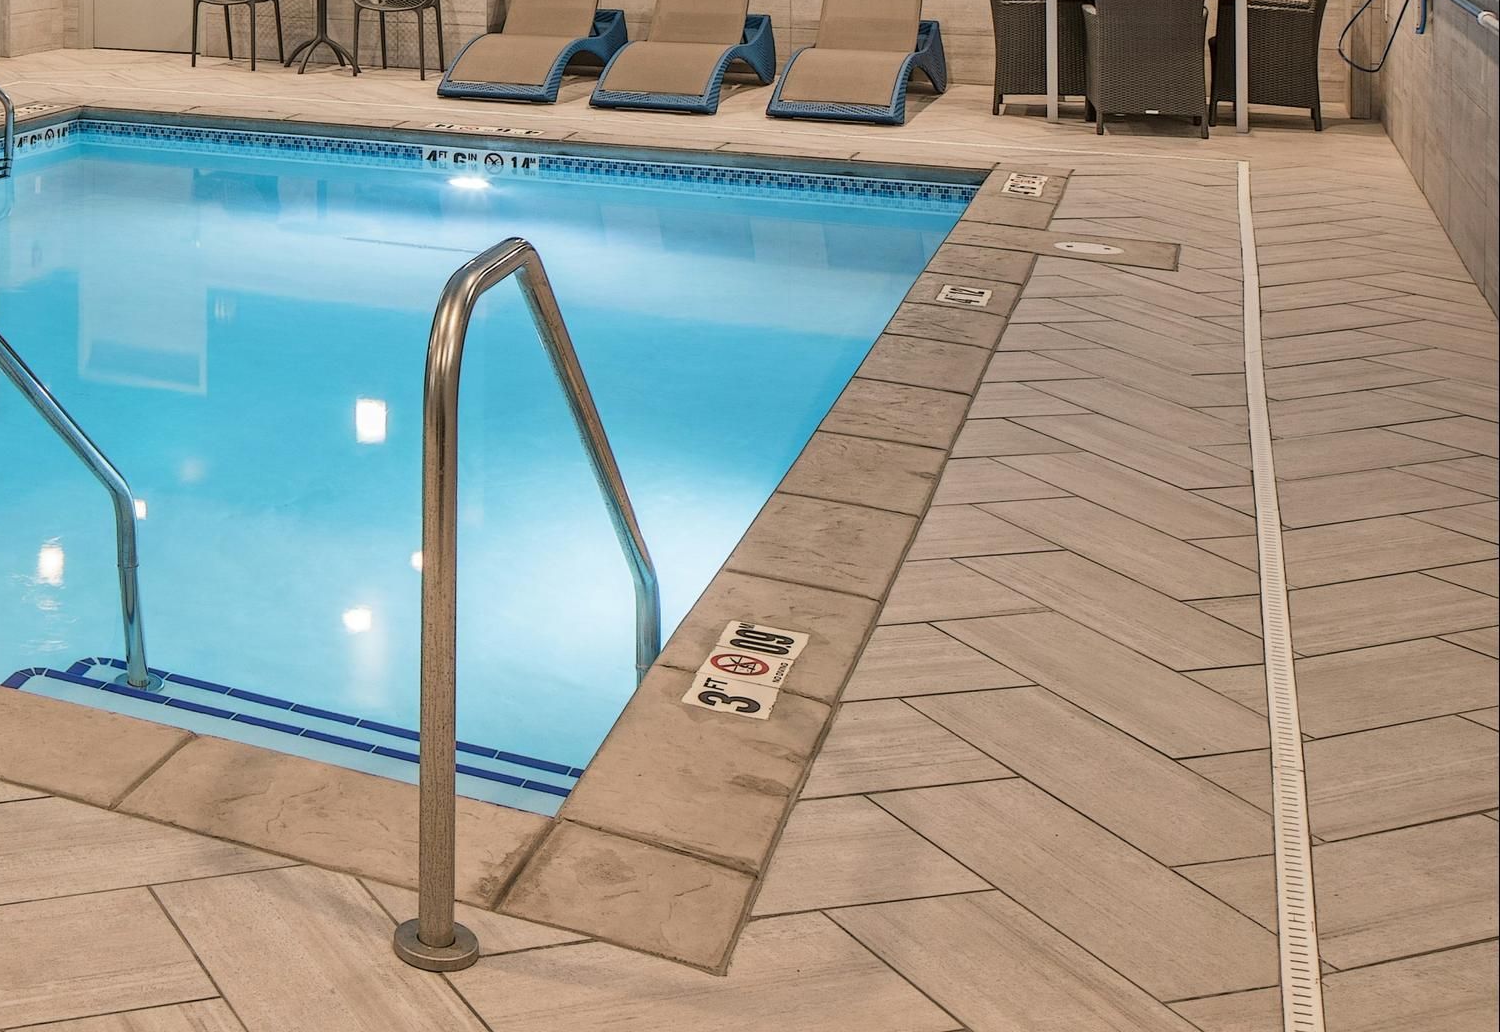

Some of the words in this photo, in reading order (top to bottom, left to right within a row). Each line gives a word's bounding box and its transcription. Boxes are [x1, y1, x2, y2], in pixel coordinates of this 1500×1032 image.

[426, 150, 437, 161] 4
[438, 150, 448, 159] FT
[468, 152, 477, 161] IN
[703, 677, 728, 691] FT
[698, 690, 761, 714] 3
